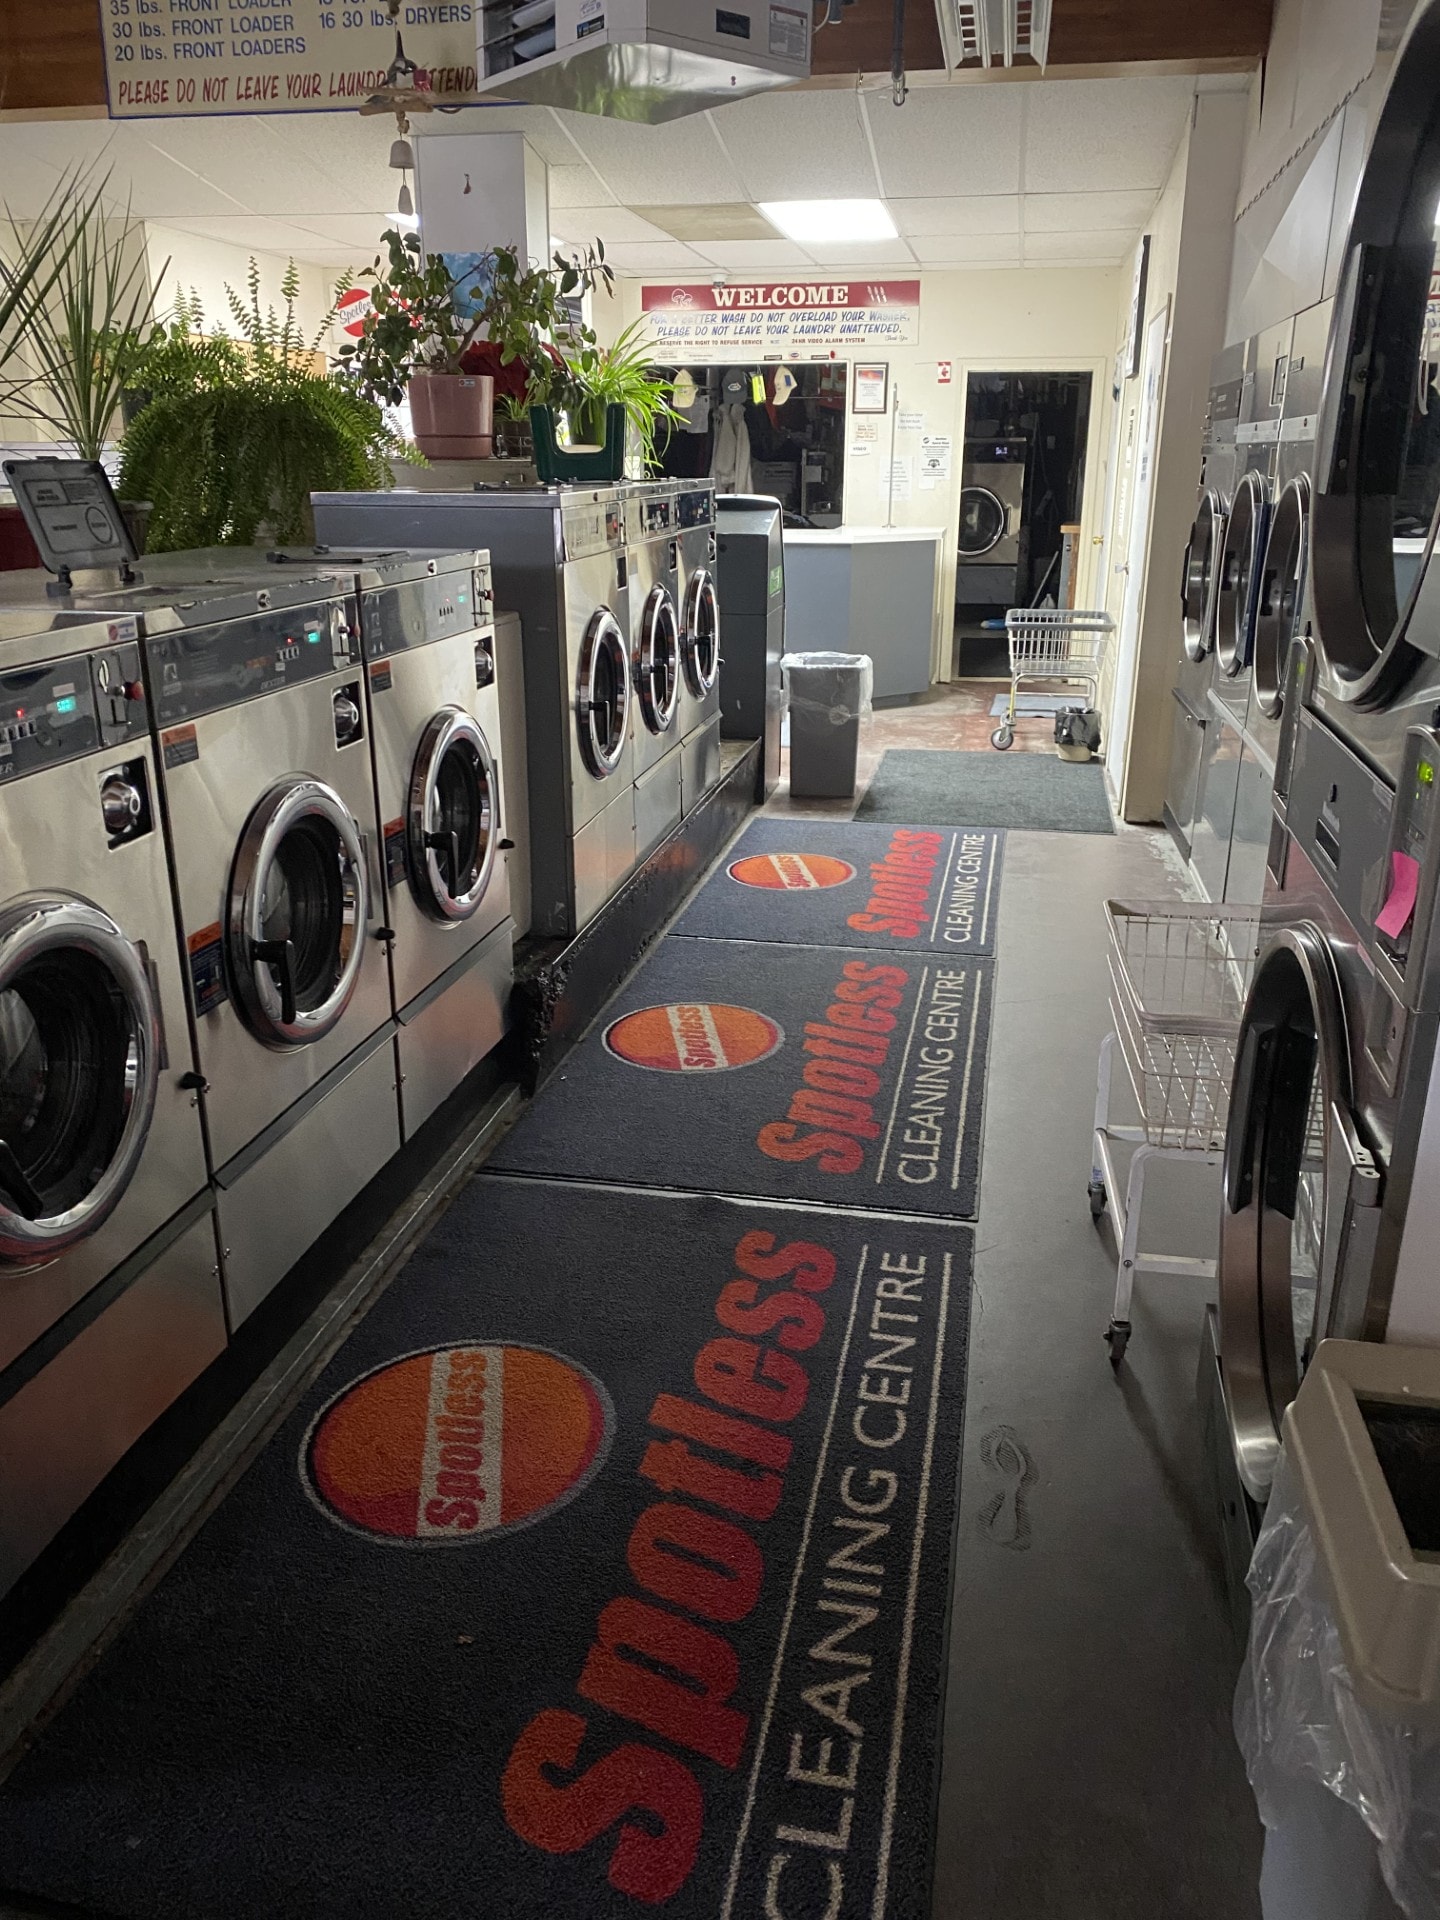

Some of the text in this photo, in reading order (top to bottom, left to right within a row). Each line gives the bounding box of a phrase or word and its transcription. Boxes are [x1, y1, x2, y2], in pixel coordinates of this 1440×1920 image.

[110, 0, 130, 15] 35
[136, 0, 163, 14] lbs.
[169, 0, 219, 13] FRONT
[112, 15, 294, 38] 30 lbs. FRONT LOADER
[319, 5, 472, 29] 16 30 lbs. DRYERS
[115, 37, 306, 61] 20 lbs. FRONT LOADERS
[118, 78, 169, 105] PLEASE
[176, 78, 196, 102] DO
[202, 76, 229, 102] NOT
[236, 75, 278, 100] LEAVE
[286, 73, 321, 99] YOUR
[330, 69, 388, 97] LAUNDR
[712, 285, 848, 307] WELCOME
[721, 313, 746, 323] WASH
[751, 313, 763, 322] DO
[768, 312, 785, 323] NOT
[789, 311, 837, 322] OVERLOAD
[841, 310, 865, 322] YOUR
[657, 323, 902, 336] PLEASE DO NOT LEAVE YOUR LAUNDRY UNATTENDED.
[847, 829, 944, 938] Spotless
[943, 833, 985, 943] CLEANING CENTRE
[683, 1005, 717, 1069] Spotless
[757, 960, 909, 1174] Spotless
[897, 969, 966, 1184] CLEANING CENTRE
[426, 1350, 488, 1531] Spotless
[502, 1229, 837, 1904] Spotless
[762, 1251, 928, 1920] CLEANING CENTRE
